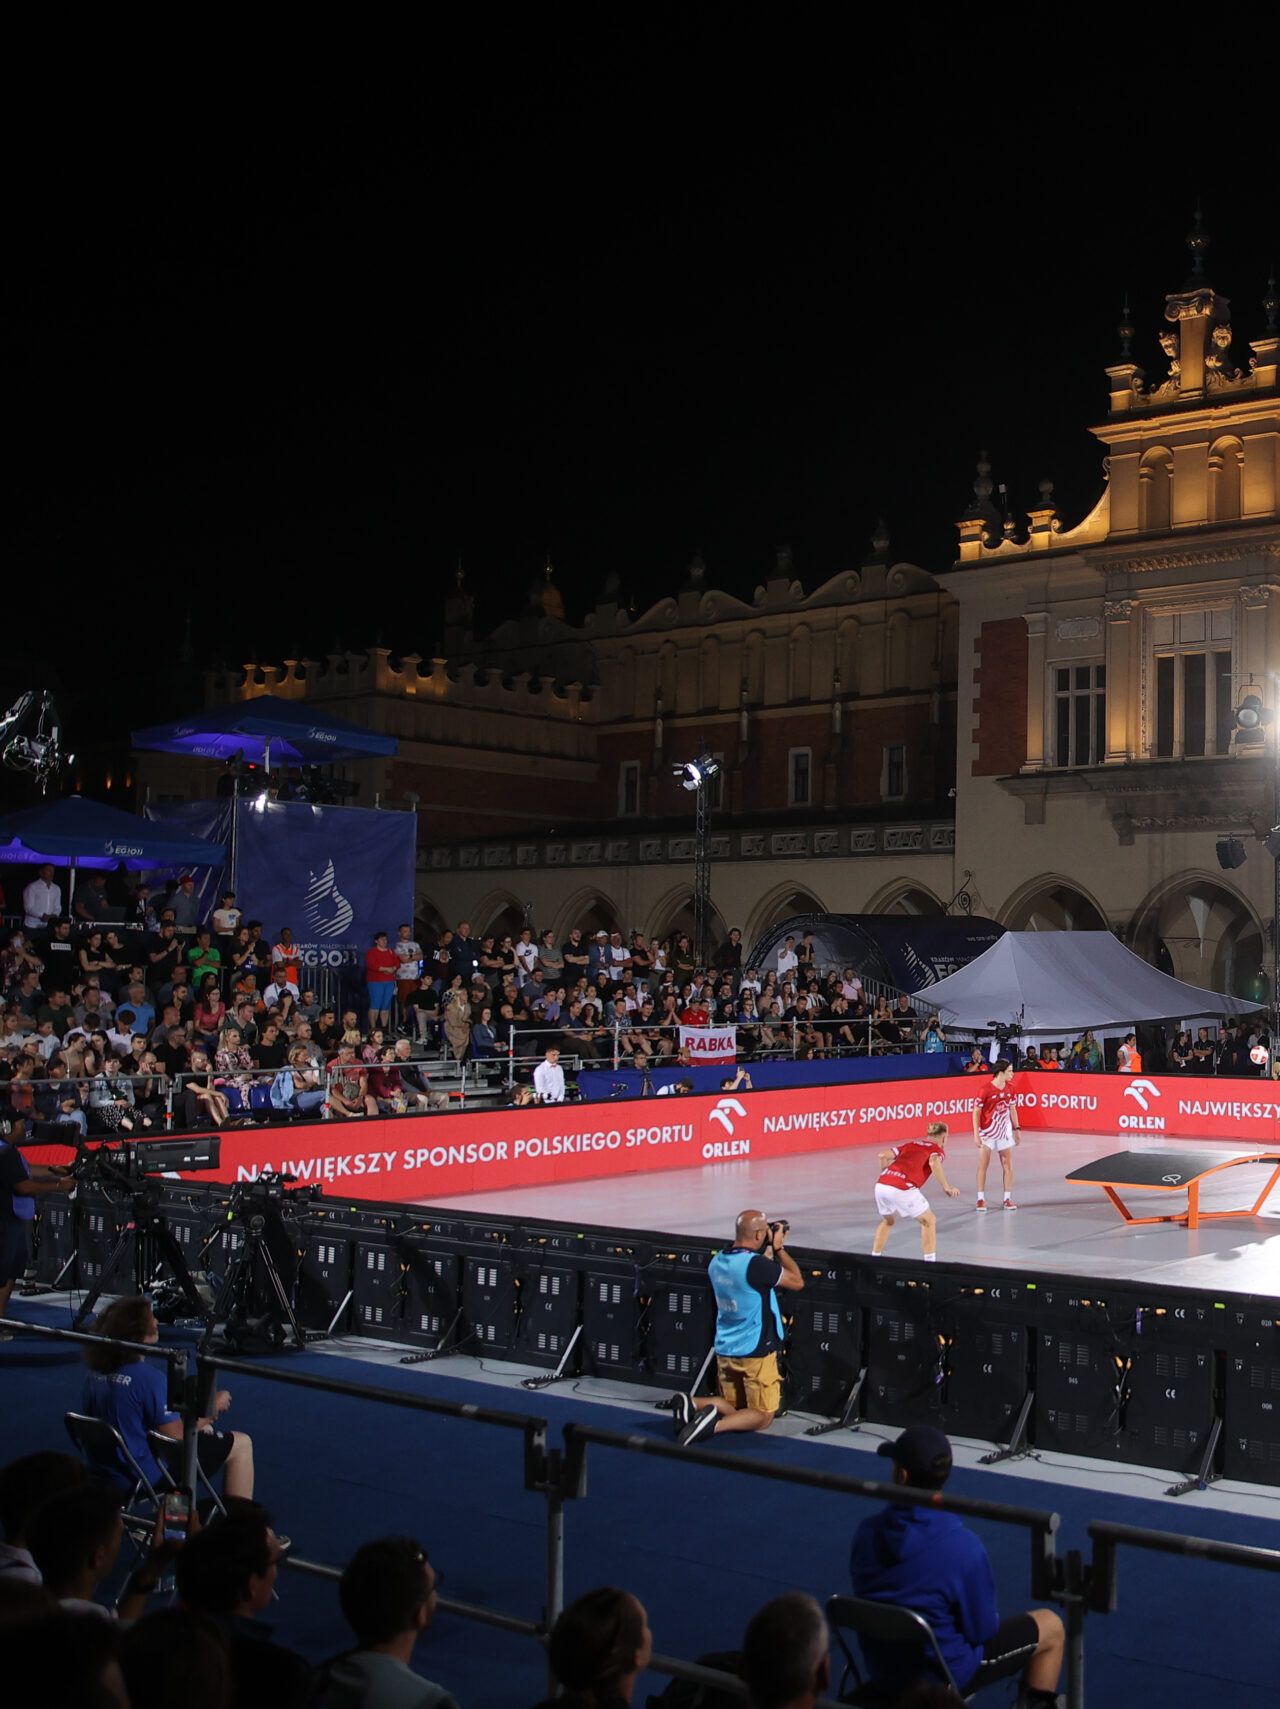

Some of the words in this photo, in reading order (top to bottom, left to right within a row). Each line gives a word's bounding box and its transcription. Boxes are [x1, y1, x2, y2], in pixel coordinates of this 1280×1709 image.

[685, 1037, 735, 1051] RABKA
[763, 1109, 856, 1133] NAJWIĘKSZY
[859, 1103, 924, 1124] SPONSOR
[1040, 1093, 1097, 1111] SPORTU
[1119, 1115, 1165, 1130] ORLEN
[237, 1150, 398, 1183] NAJWIĘKSZY
[403, 1138, 508, 1169] SPONSOR
[514, 1130, 621, 1159] POLSKIEGO
[626, 1123, 694, 1148] SPORTU
[702, 1139, 750, 1159] ORLEN
